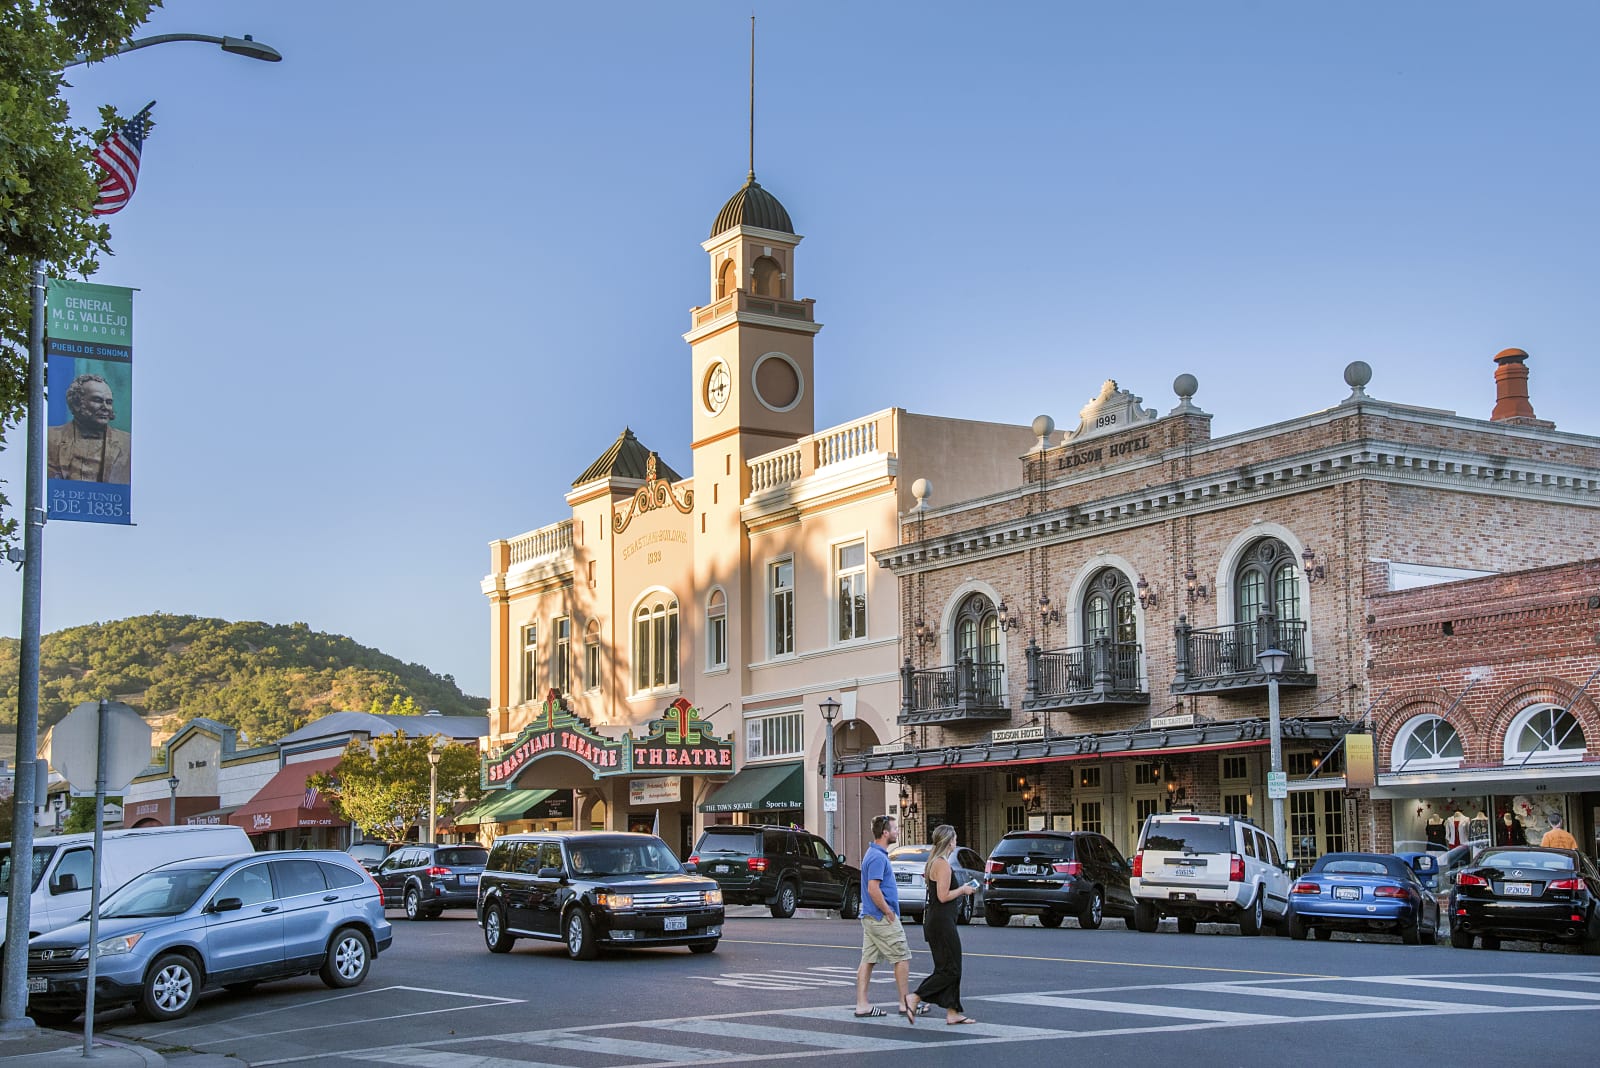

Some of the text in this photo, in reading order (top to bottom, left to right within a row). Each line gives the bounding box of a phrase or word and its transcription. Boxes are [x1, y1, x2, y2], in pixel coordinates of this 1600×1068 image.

[65, 297, 115, 313] GENERAL
[53, 308, 128, 327] M. G. VALLEJO
[55, 321, 125, 336] FUNDADOR
[51, 342, 129, 358] PUEBLO DE SONOMA
[1095, 414, 1117, 428] 1999
[1058, 435, 1150, 470] LEDSON HOTEL
[53, 489, 122, 503] 24 DE JUNIO
[53, 499, 123, 517] DE 1835
[647, 550, 662, 565] 1933
[993, 728, 1043, 741] LEDSON HOTEL
[489, 732, 618, 781] SEBASTIANI THEATRE
[634, 748, 731, 766] THEATRE
[706, 802, 753, 812] THE TOWN SQUARE
[766, 800, 802, 808] Sports Bar
